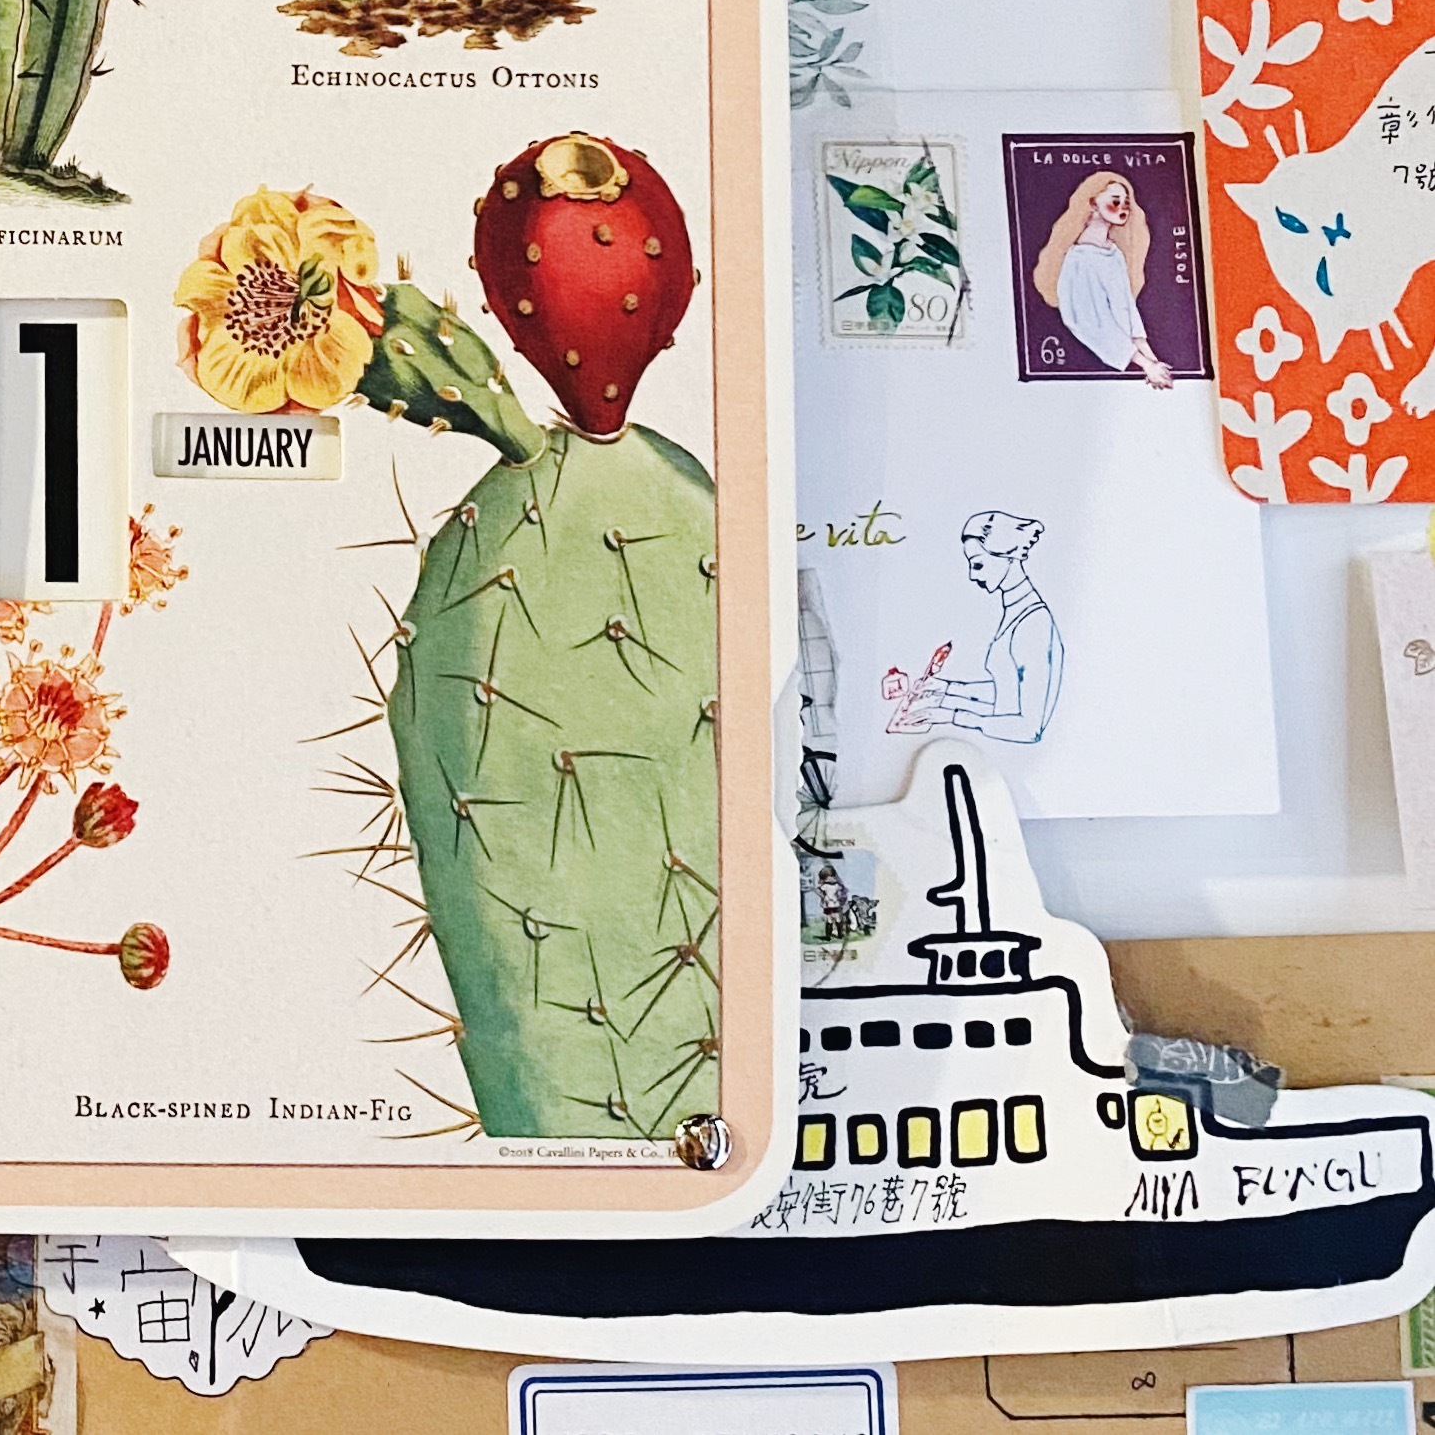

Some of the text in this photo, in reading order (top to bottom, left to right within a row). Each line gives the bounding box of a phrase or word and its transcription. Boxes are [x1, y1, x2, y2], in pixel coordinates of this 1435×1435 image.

[291, 64, 599, 89] ECHINOCACTUS OTTONIS
[829, 149, 909, 174] Nippon
[1033, 152, 1053, 164] LA
[1063, 153, 1111, 165] DOLCE
[1173, 226, 1190, 283] POSTE
[908, 293, 948, 322] 80
[177, 427, 313, 468] JANUARY
[826, 500, 906, 547] vita
[75, 1095, 413, 1121] BLACK-SPINED INDIAN-FIG
[537, 1146, 584, 1158] Cavallini
[589, 1147, 623, 1160] Papers
[627, 1147, 636, 1157] &
